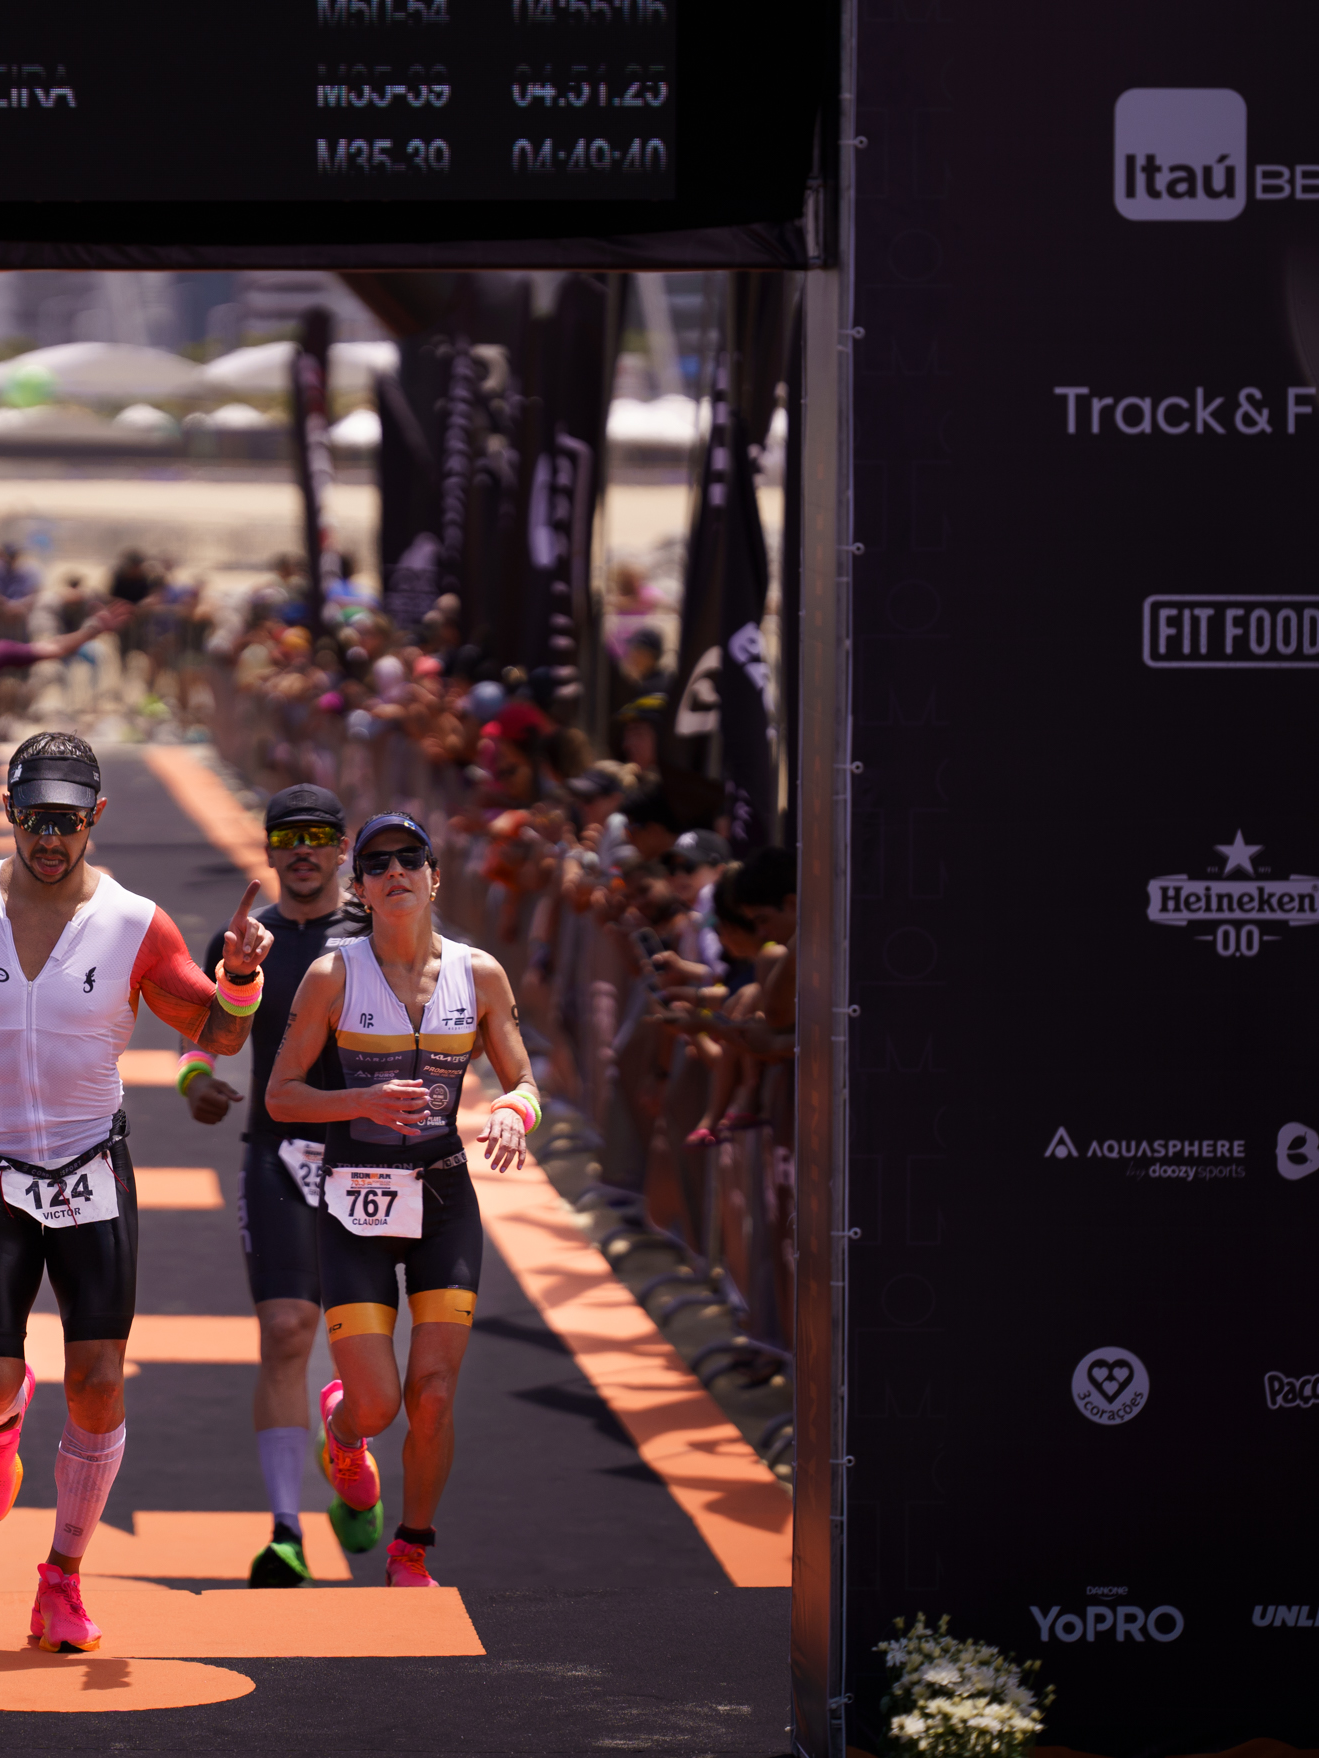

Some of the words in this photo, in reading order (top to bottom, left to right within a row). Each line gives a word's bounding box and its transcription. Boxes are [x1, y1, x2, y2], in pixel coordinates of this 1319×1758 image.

[317, 64, 450, 107] M35-39
[317, 138, 450, 174] M35-39
[1125, 153, 1236, 199] Itaú
[1053, 386, 1227, 435] Track
[1234, 386, 1274, 436] &
[1287, 386, 1317, 434] F
[1159, 607, 1215, 655] FIT
[1158, 883, 1317, 914] Heineken
[1216, 924, 1261, 958] 0.0
[442, 1016, 475, 1027] TEO
[1086, 1139, 1245, 1160] AQUASPHERE
[25, 1173, 94, 1210] 124
[350, 1172, 392, 1180] IRONMAN
[43, 1207, 82, 1220] VICTOR
[345, 1189, 399, 1218] 767
[351, 1218, 388, 1226] CLAUDIA
